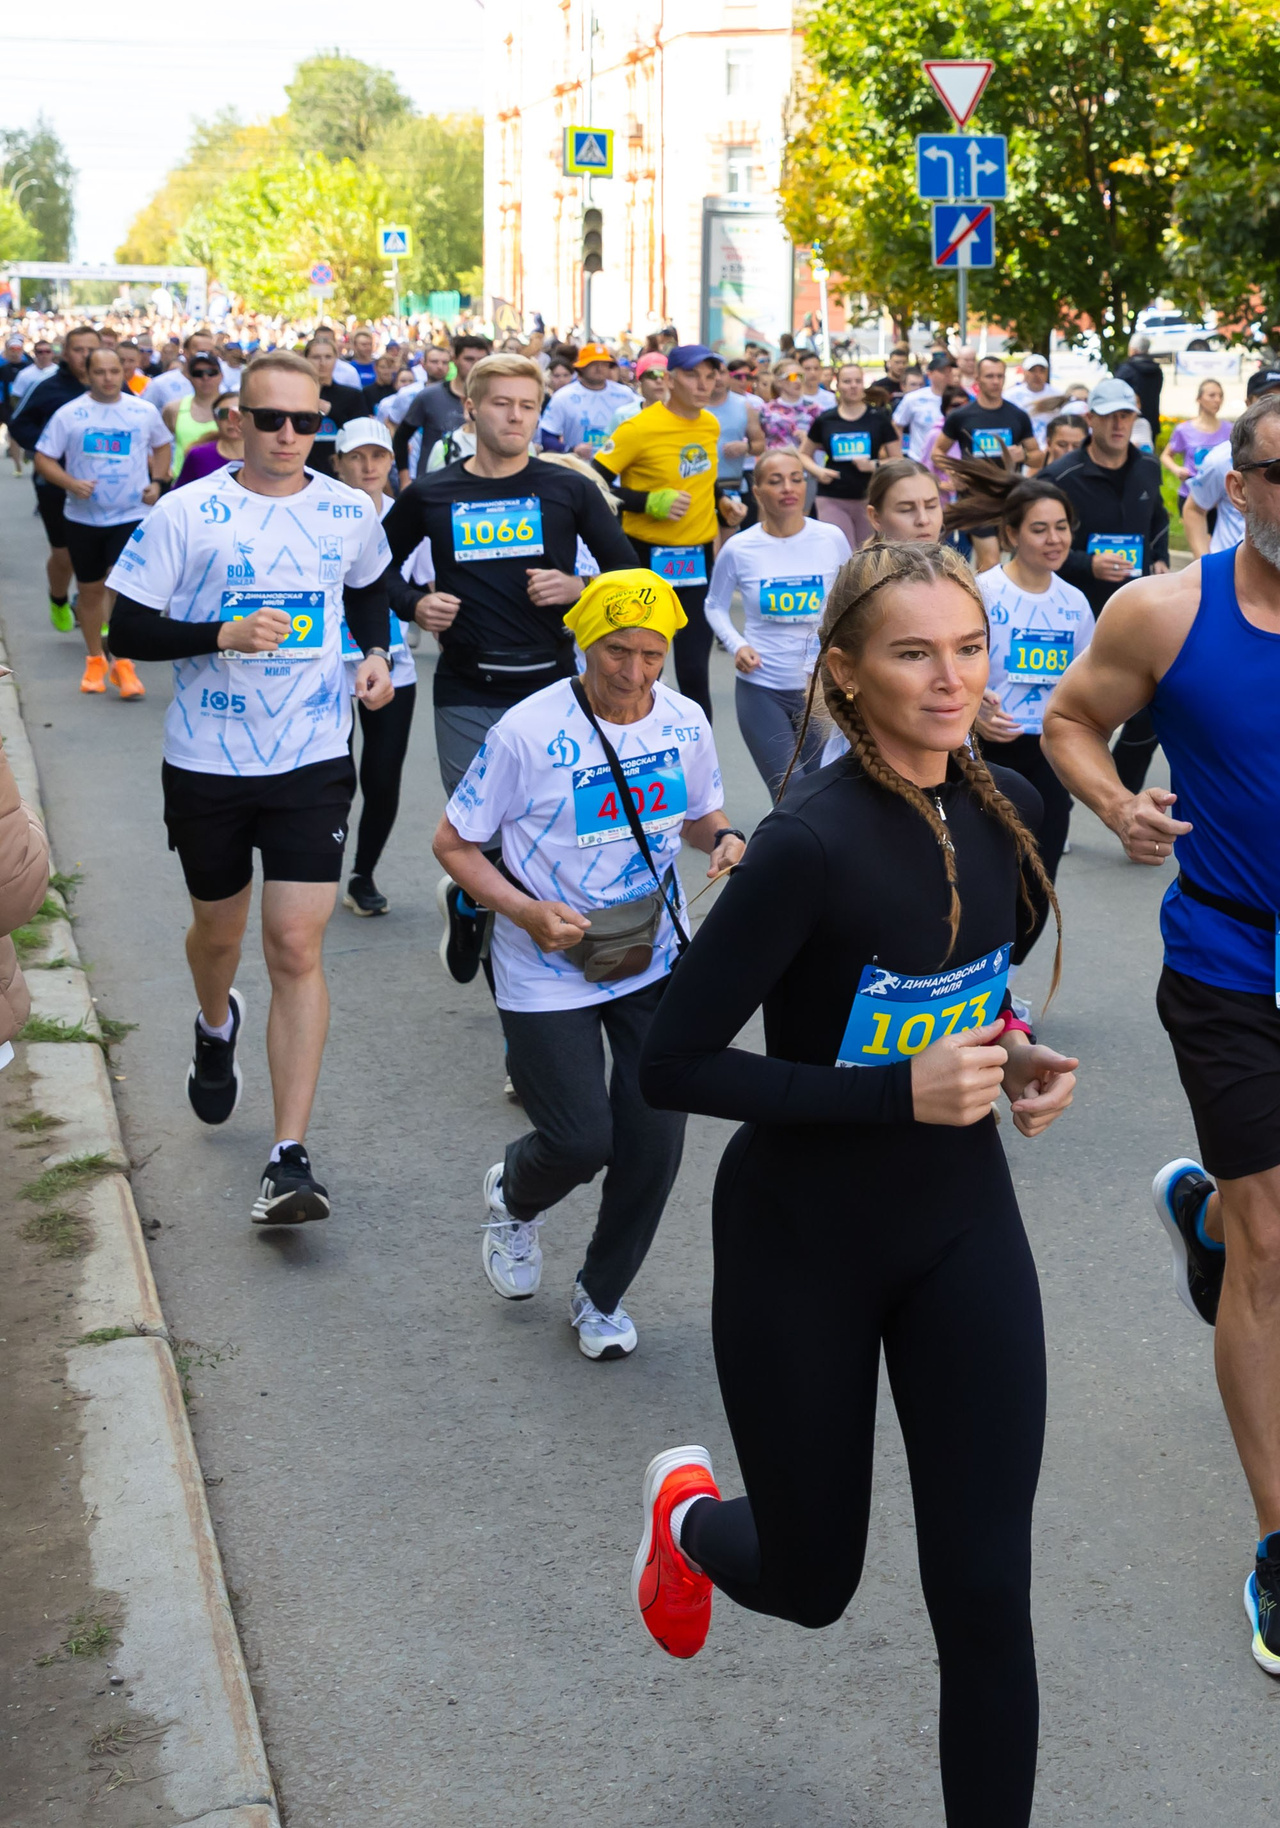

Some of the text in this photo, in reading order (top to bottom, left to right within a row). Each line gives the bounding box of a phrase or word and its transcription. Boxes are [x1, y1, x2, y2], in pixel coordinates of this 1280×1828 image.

[332, 504, 363, 518] ВТБ
[460, 517, 534, 545] 1066
[663, 560, 695, 576] 474
[768, 591, 820, 611] 1076
[1017, 647, 1068, 671] 1083
[597, 782, 668, 820] 402
[901, 959, 987, 990] ДИНАМОВСКАЯ
[930, 980, 962, 998] МИЛЯ
[862, 991, 992, 1056] 1073
